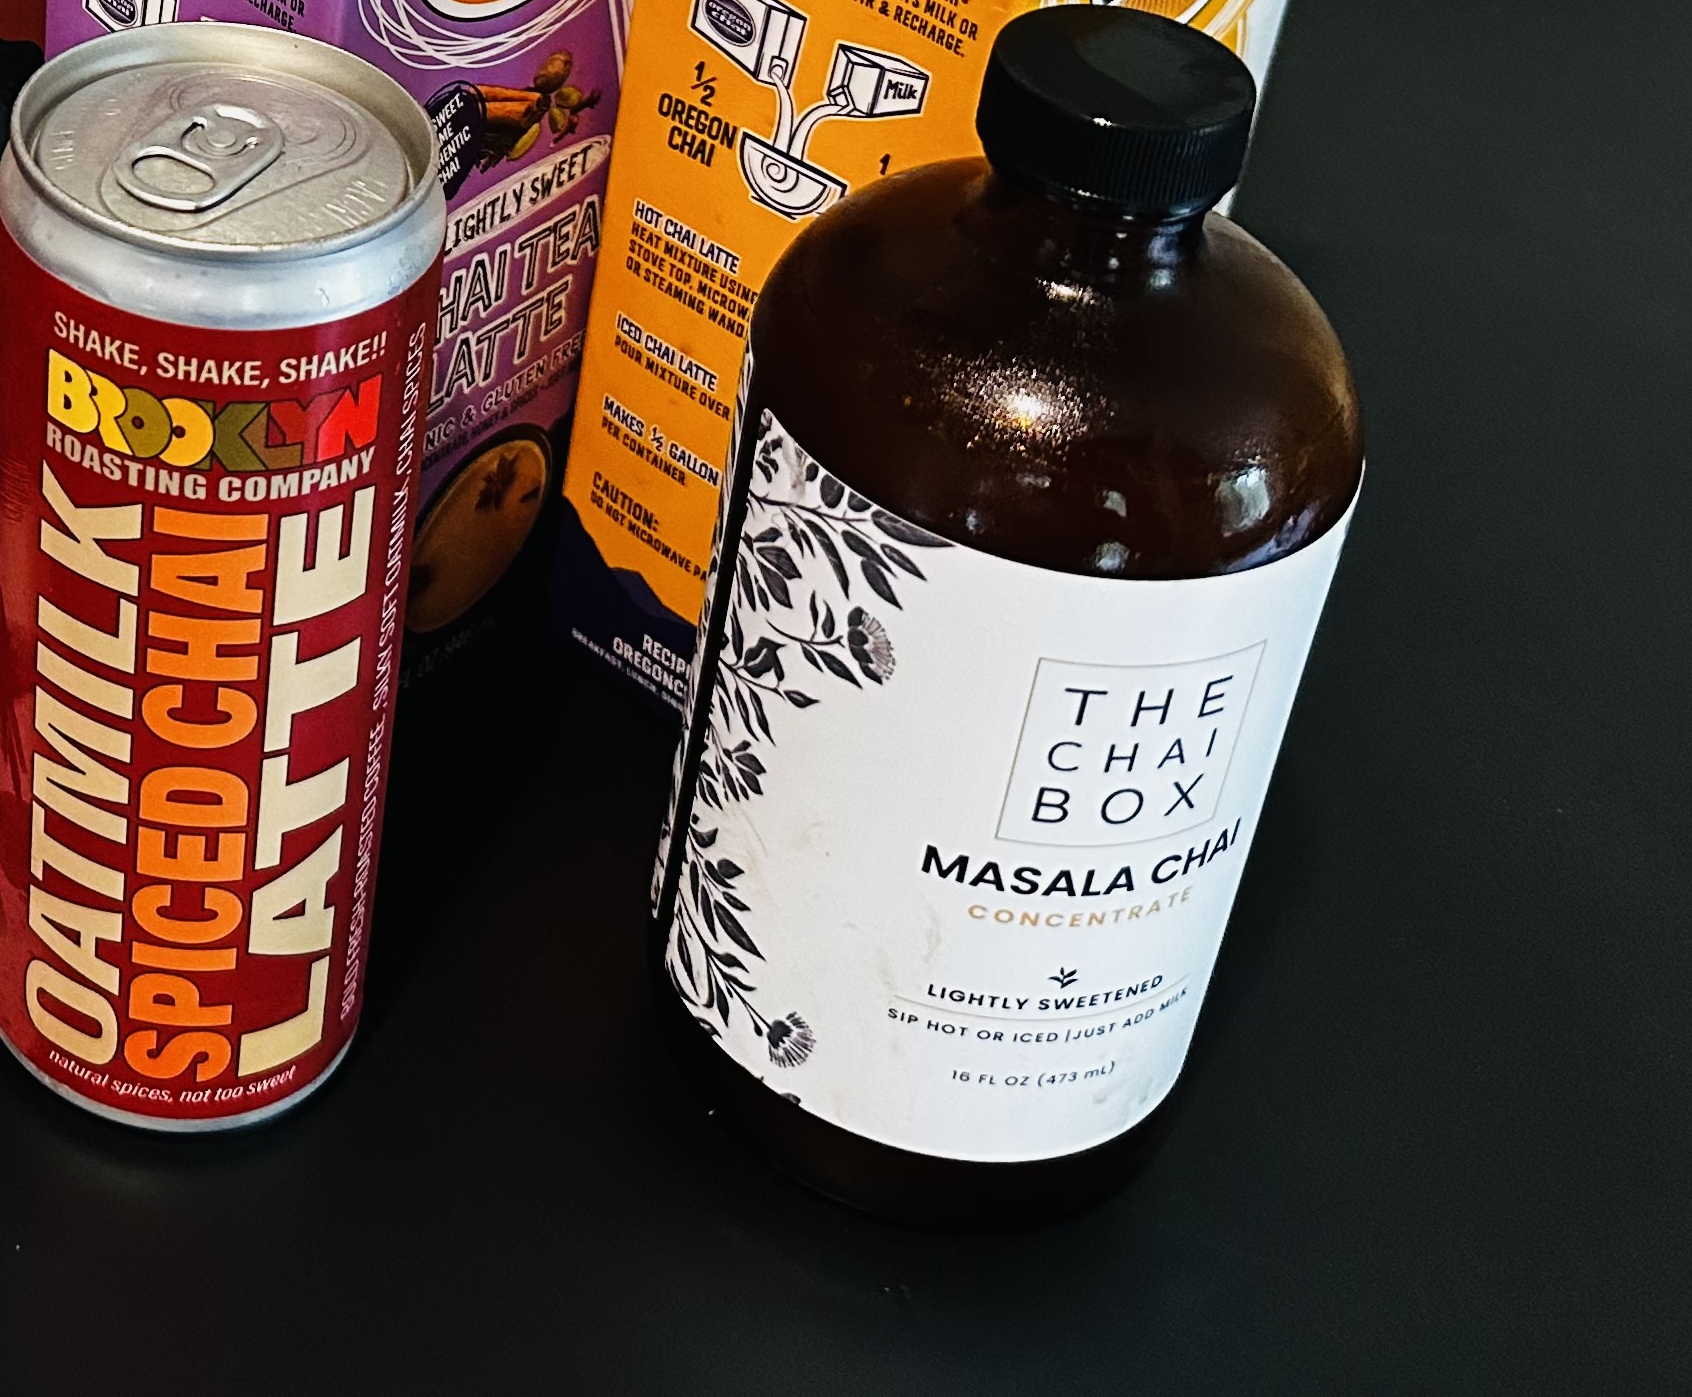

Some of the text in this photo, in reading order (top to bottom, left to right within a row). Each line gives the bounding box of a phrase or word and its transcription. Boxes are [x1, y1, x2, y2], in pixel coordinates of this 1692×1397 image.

[878, 0, 889, 17] &
[893, 8, 965, 59] RECHARGE.
[959, 20, 978, 41] OR
[882, 79, 918, 101] Milk
[657, 93, 738, 150] OREGON
[667, 127, 716, 168] CHAI
[444, 182, 525, 255] IGHTLY
[529, 144, 593, 203] SWEET
[435, 201, 600, 345] HAI TEA
[53, 310, 388, 390] SHAKE, SHAKE, SHAKE!!
[403, 322, 426, 414] SPICES
[46, 348, 384, 473] BROOKLYN
[46, 420, 376, 503] ROASTING COMPANY
[397, 414, 416, 475] CHAI
[593, 471, 660, 532] CAUTION:
[1064, 674, 1234, 727] THE
[24, 460, 144, 1068] OATMILK
[1047, 727, 1218, 774] CHAI
[123, 505, 270, 1085] SPICED CHAI
[237, 483, 377, 1079] LATTE
[1031, 773, 1204, 826] BOX
[920, 816, 1241, 898] MASALA CHAI
[967, 885, 1193, 928] CONCENTRATE
[887, 1007, 919, 1025] SIP
[926, 1019, 968, 1037] HOT
[976, 1029, 1004, 1042] OR
[1013, 1031, 1058, 1044] ICED
[1121, 1007, 1155, 1030] ADD
[1158, 987, 1188, 1013] MILK
[927, 974, 1164, 1011] LIGHTLY SWEETENED
[48, 1049, 298, 1103] natural spices, not too sweet
[952, 1069, 970, 1084] 16
[978, 1073, 996, 1085] FL
[1004, 1074, 1030, 1087] OZ
[1037, 1071, 1078, 1088] (473
